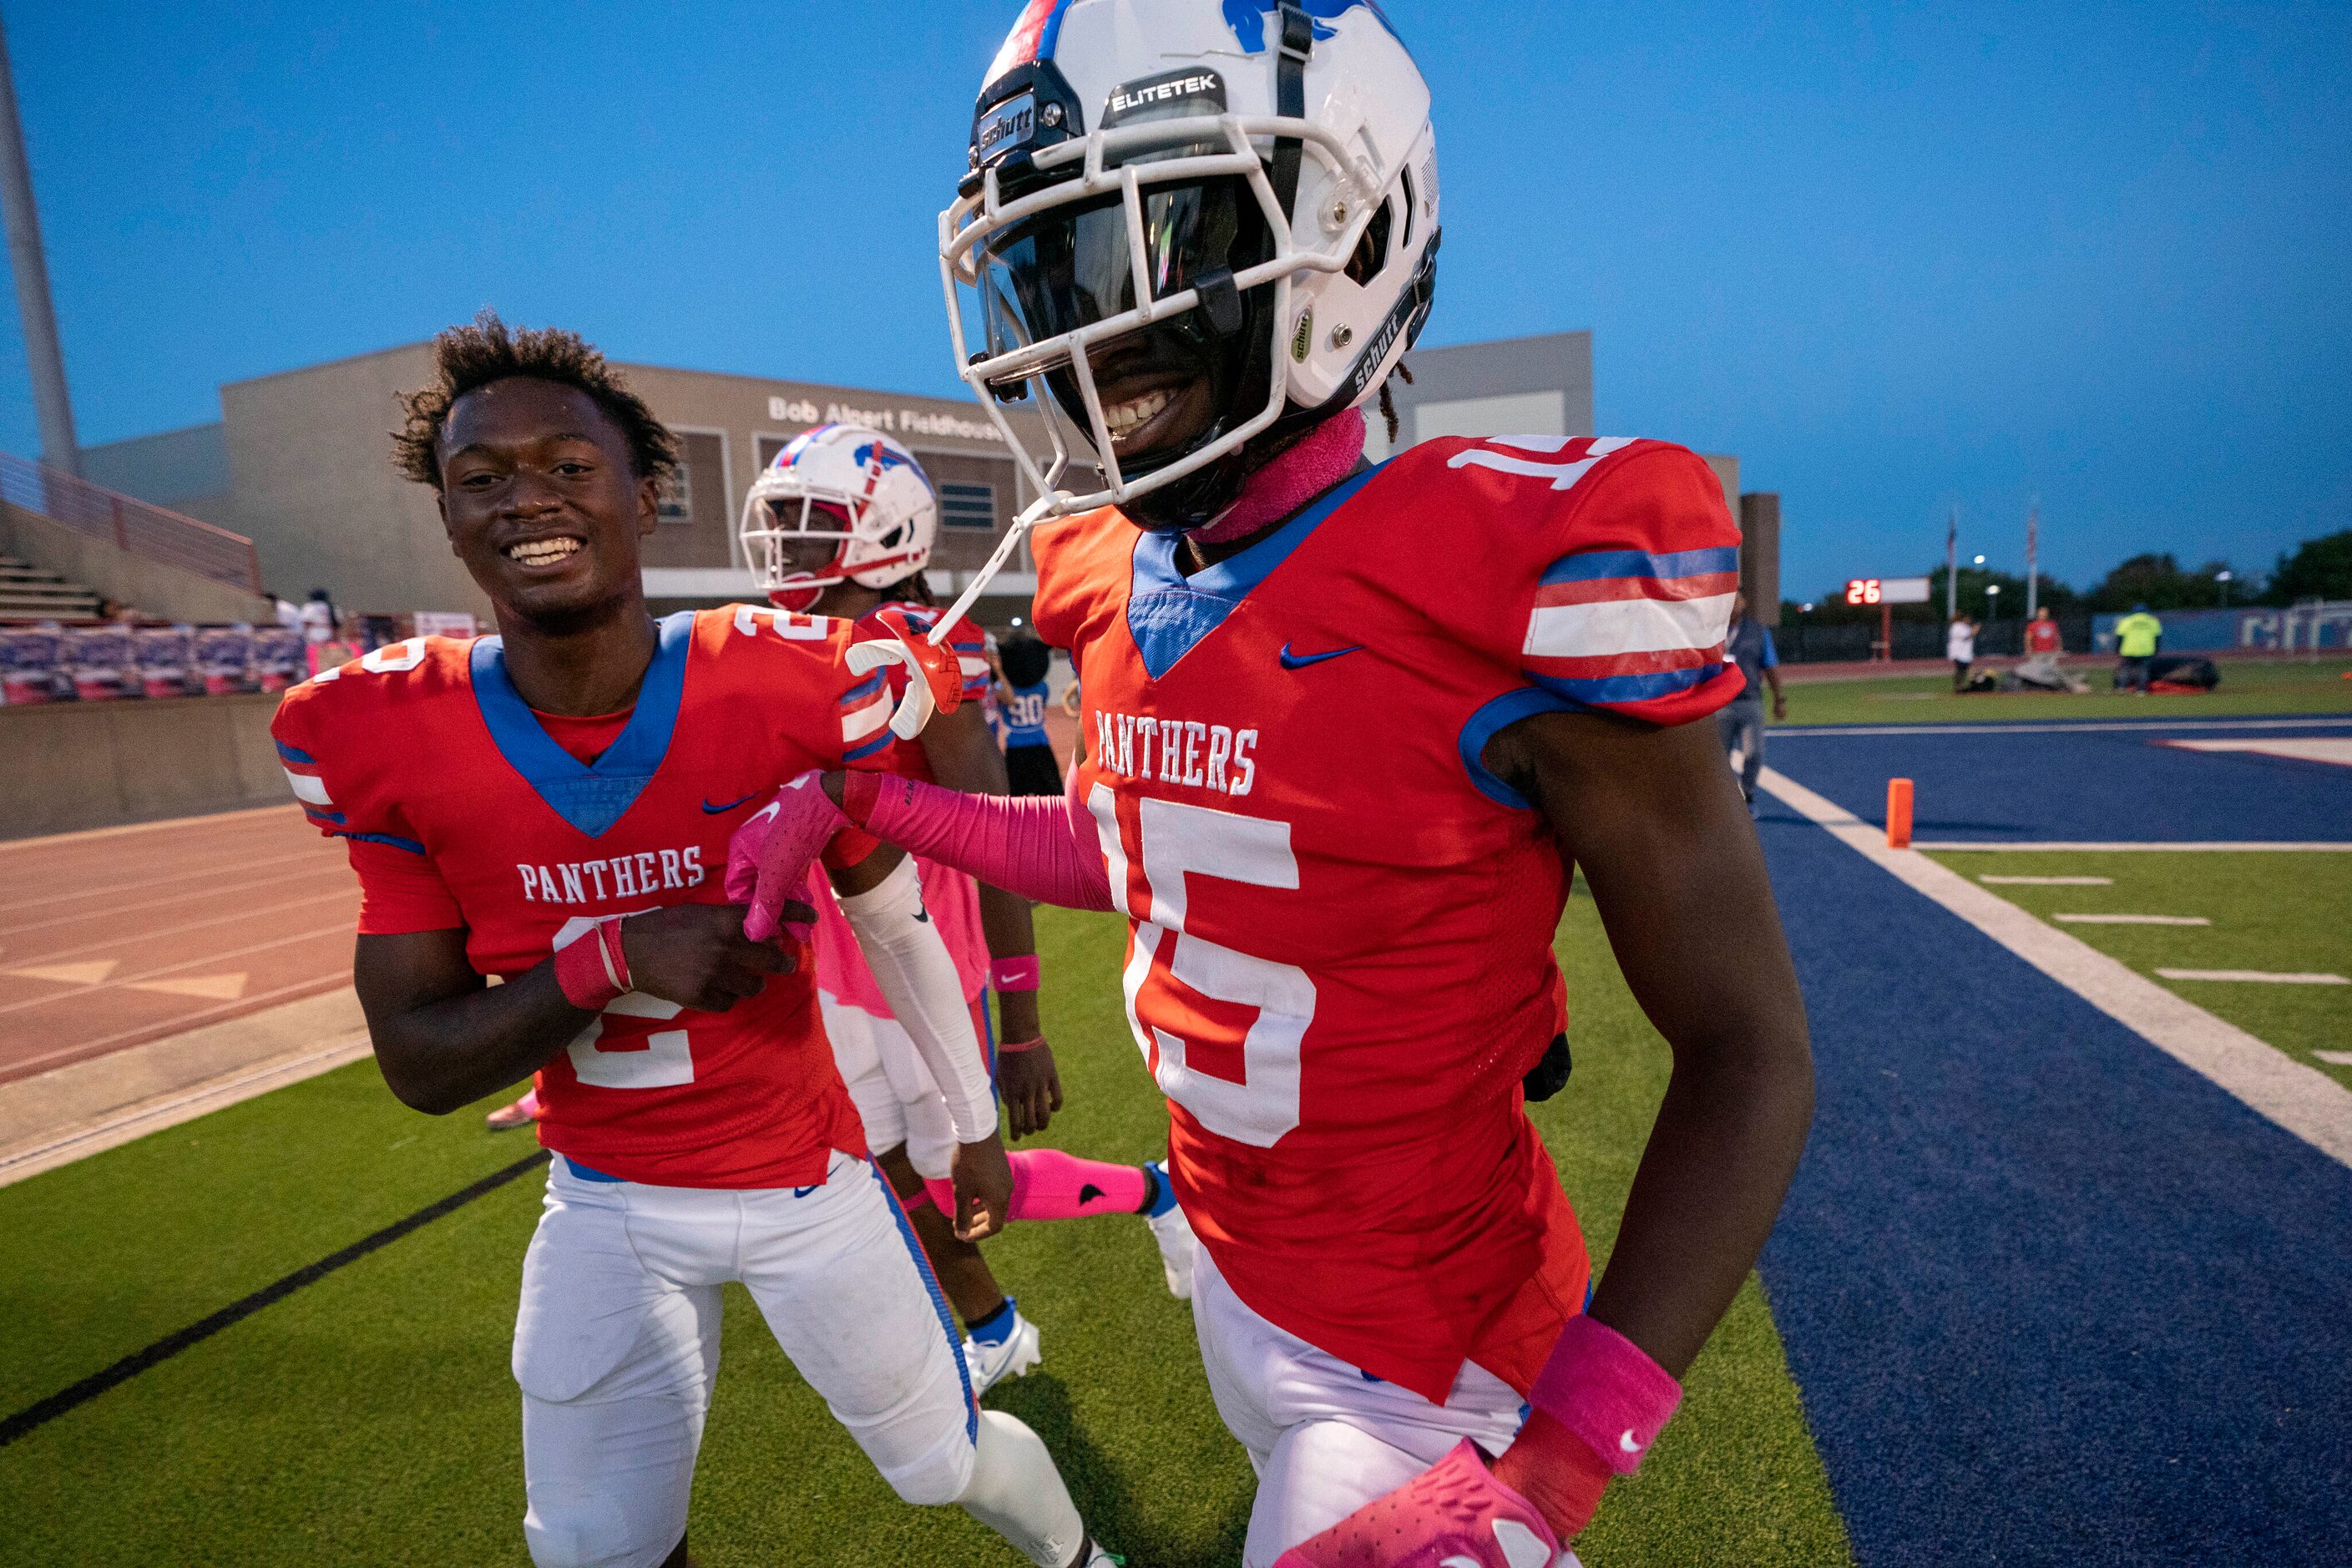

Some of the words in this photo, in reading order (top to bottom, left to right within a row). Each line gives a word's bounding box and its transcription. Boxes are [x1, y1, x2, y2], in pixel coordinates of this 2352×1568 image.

[1112, 74, 1216, 112] ELITETEK
[981, 106, 1033, 152] schutt
[1354, 313, 1400, 393] schutt
[768, 397, 820, 423] Bob
[1847, 579, 1881, 604] 26
[517, 837, 706, 904] PANTHERS
[1087, 781, 1317, 1148] 15
